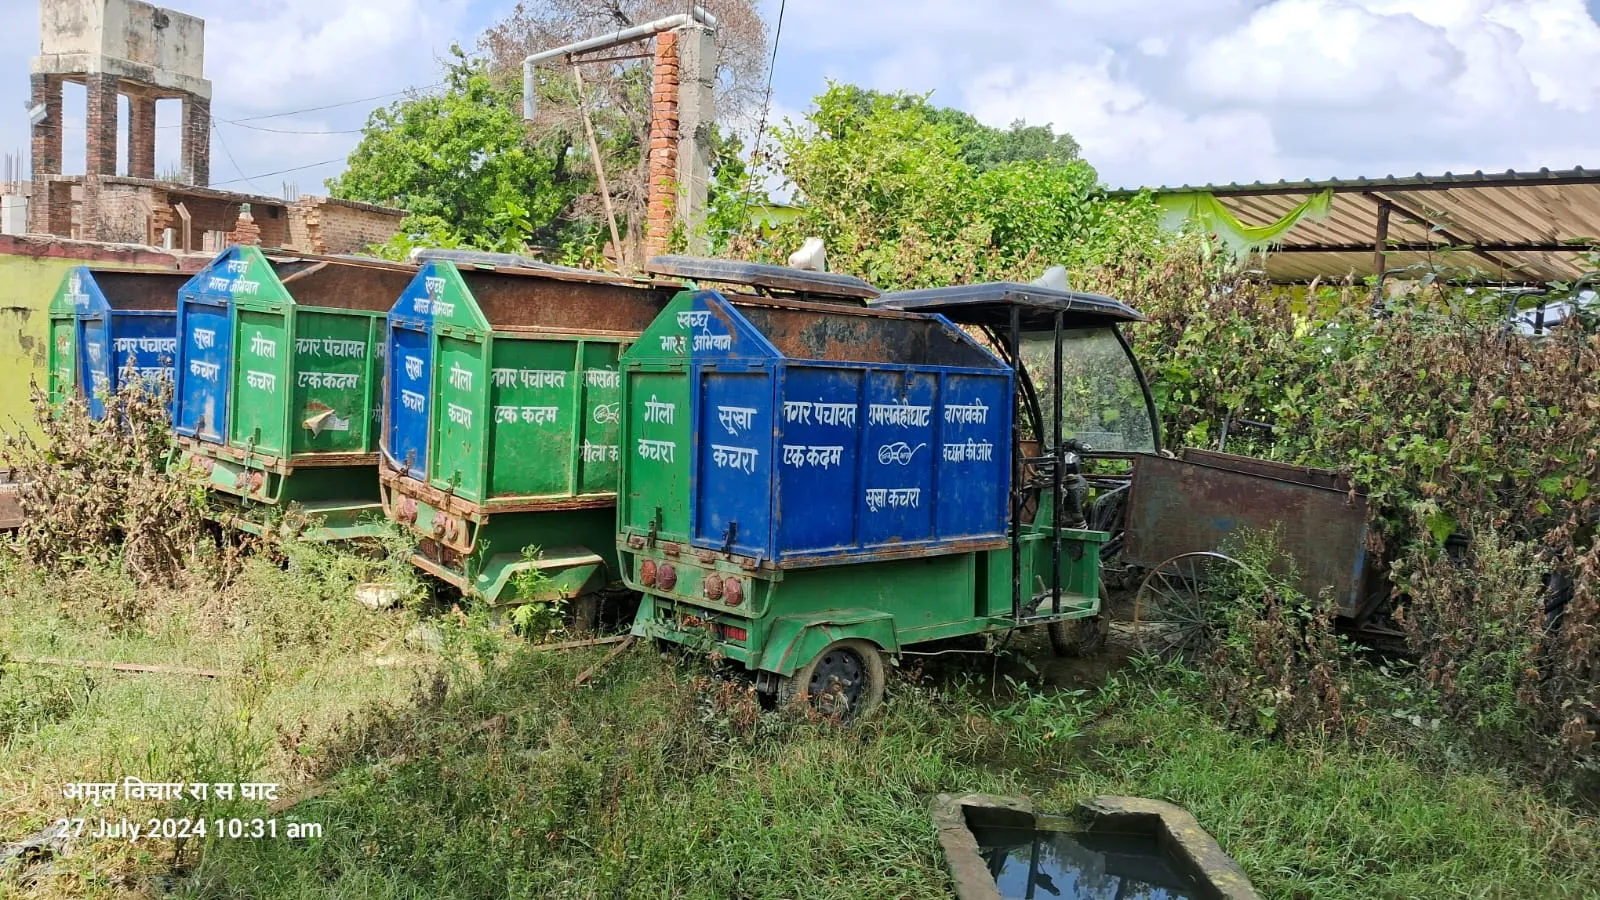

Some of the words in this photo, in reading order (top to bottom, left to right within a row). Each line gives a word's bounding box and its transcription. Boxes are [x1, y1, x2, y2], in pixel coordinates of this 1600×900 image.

[209, 276, 229, 292] भारत
[676, 310, 711, 330] स्वच्छ
[193, 328, 216, 350] सूखा
[251, 331, 276, 358] गीला
[295, 338, 321, 357] नगर
[322, 336, 366, 359] पंचायत
[692, 328, 732, 352] अभियान
[190, 360, 220, 383] कचरा
[405, 355, 424, 381] सूखा
[449, 361, 473, 392] गीला
[491, 368, 518, 389] नगर
[519, 366, 566, 389] पंचायत
[247, 370, 276, 394] कचरा
[298, 371, 322, 389] एक
[323, 372, 360, 391] कदम
[401, 389, 425, 414] कचरा
[644, 394, 675, 425] गीला
[783, 401, 813, 425] नगर
[813, 396, 858, 428] पंचायत
[944, 397, 989, 424] बाराबंकी
[448, 402, 472, 429] कचरा
[521, 406, 559, 426] कदम
[717, 405, 757, 437] सूखा
[637, 438, 676, 463] कचरा
[711, 444, 759, 475] कचरा
[783, 444, 806, 468] एक
[806, 446, 844, 470] कदम
[965, 437, 977, 461] की
[976, 438, 993, 462] ओर
[866, 488, 888, 512] सूखा
[888, 488, 920, 509] कचरा
